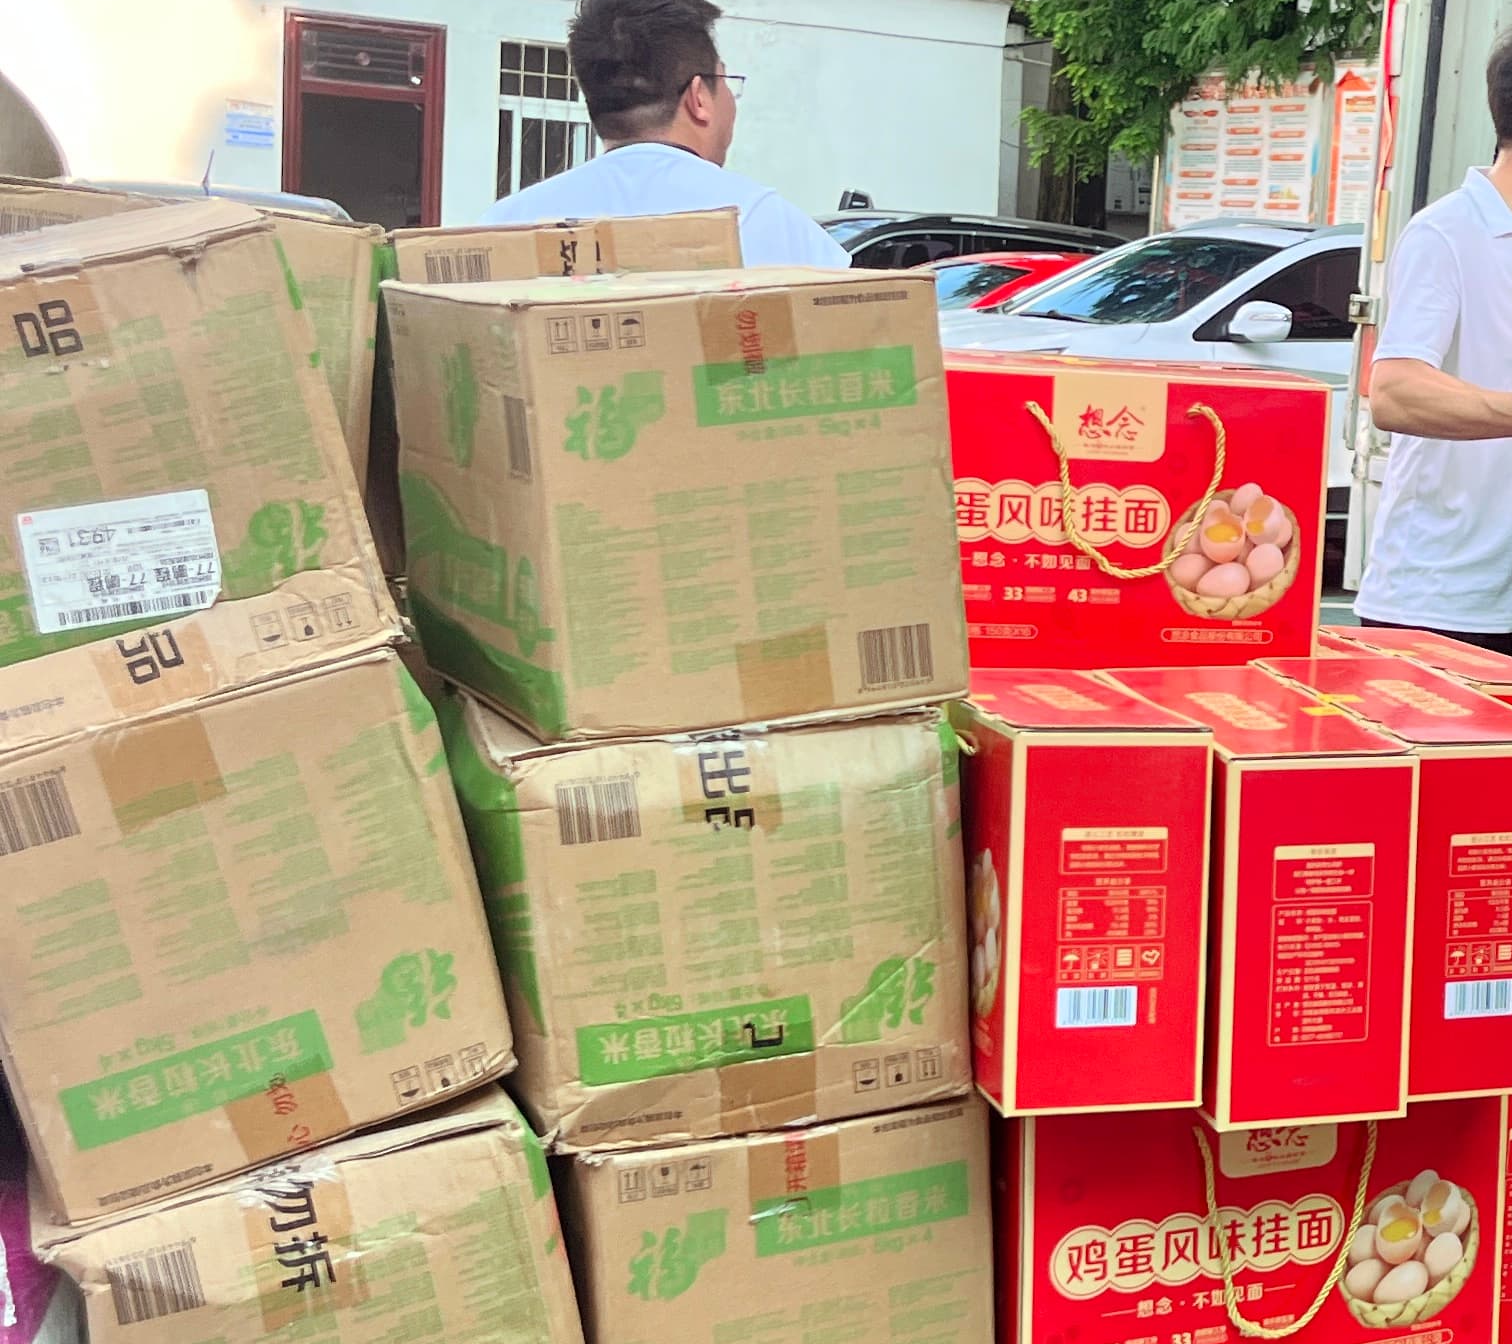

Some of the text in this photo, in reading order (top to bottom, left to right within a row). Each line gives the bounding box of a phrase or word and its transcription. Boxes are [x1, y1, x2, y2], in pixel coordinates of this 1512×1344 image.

[1077, 404, 1145, 442] 想念
[1002, 586, 1024, 601] 33
[1067, 588, 1088, 603] 43
[1066, 1207, 1335, 1286] 鸡蛋风味挂面
